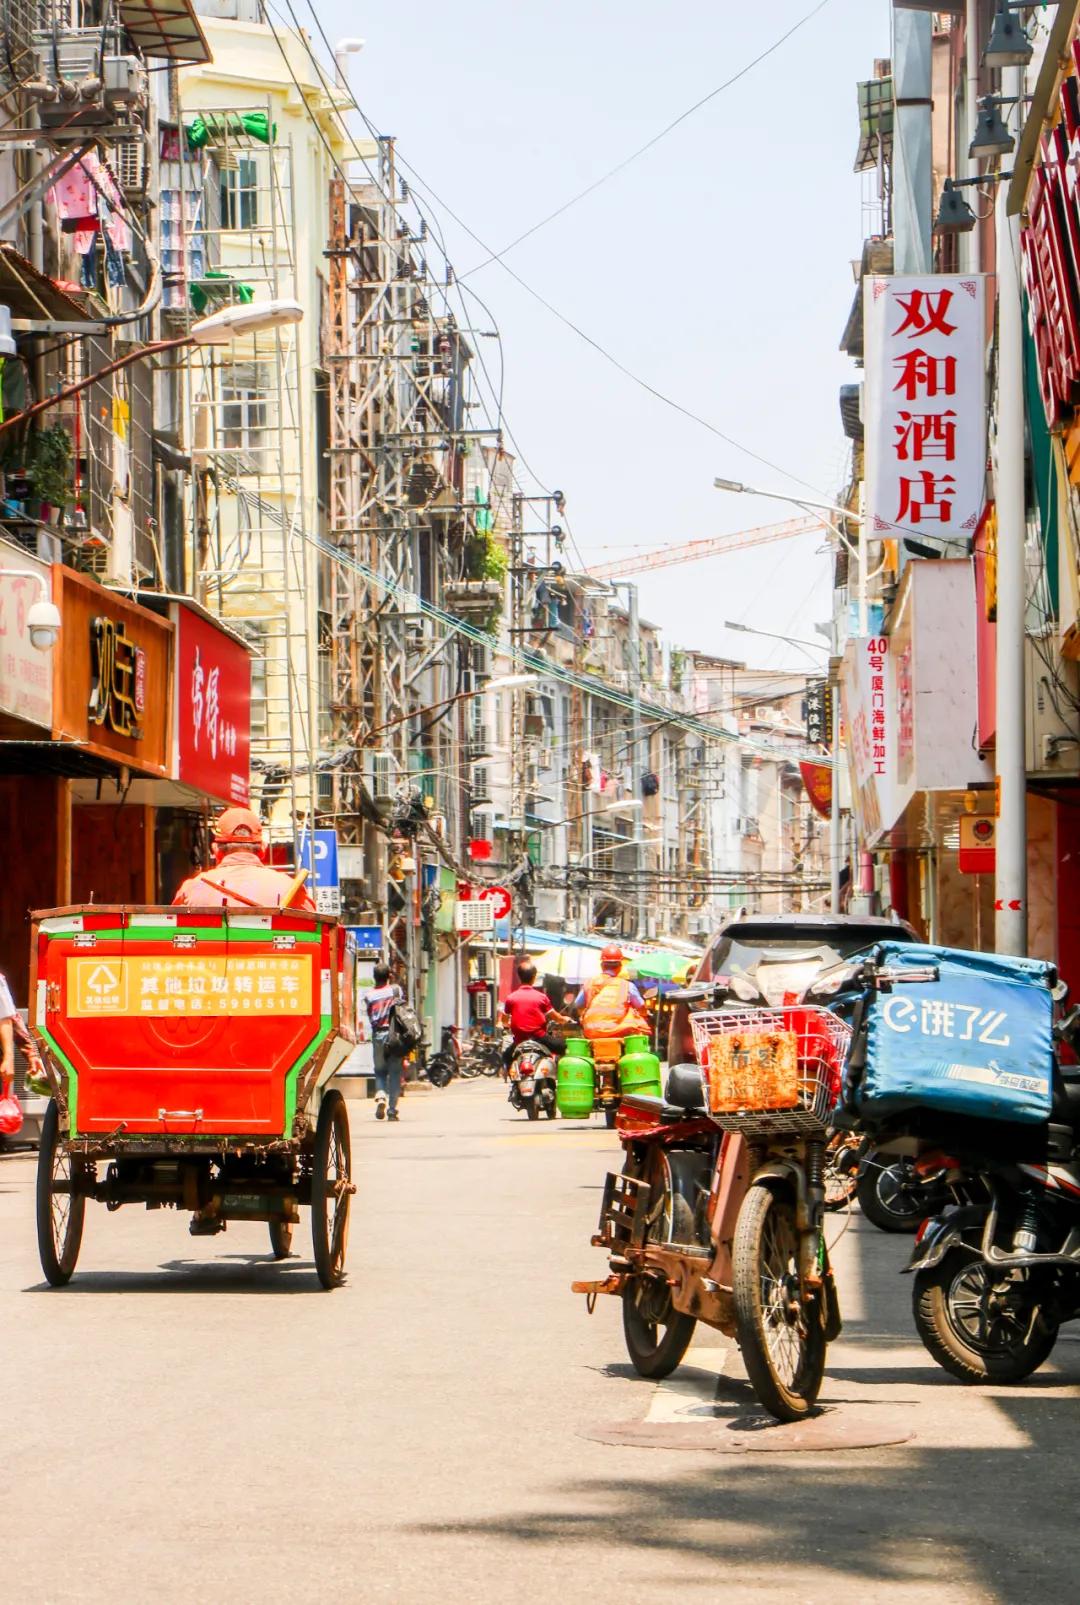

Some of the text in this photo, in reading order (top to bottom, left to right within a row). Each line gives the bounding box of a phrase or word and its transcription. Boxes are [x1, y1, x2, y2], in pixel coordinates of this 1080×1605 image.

[891, 288, 958, 523] 双和酒店
[307, 840, 329, 879] P
[485, 891, 508, 914] 停
[141, 976, 299, 994] 其他垃圾转运车
[921, 999, 1010, 1047] 饿了么
